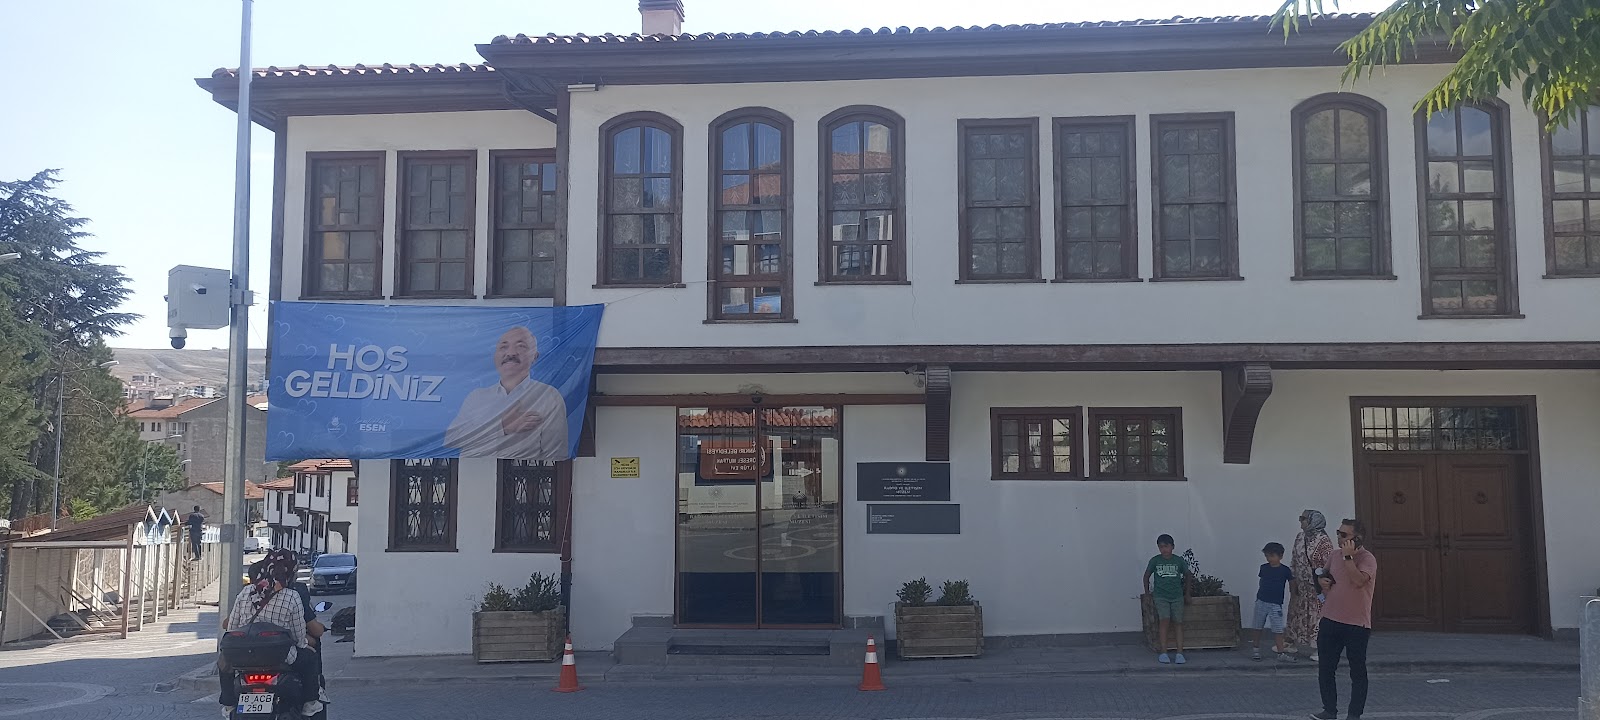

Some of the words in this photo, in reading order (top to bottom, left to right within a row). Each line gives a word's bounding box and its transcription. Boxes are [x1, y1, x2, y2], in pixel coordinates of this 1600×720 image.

[327, 343, 409, 372] HOŞ
[284, 369, 446, 402] GELDİNİZ
[359, 423, 386, 432] ESEN
[246, 704, 263, 712] 250
